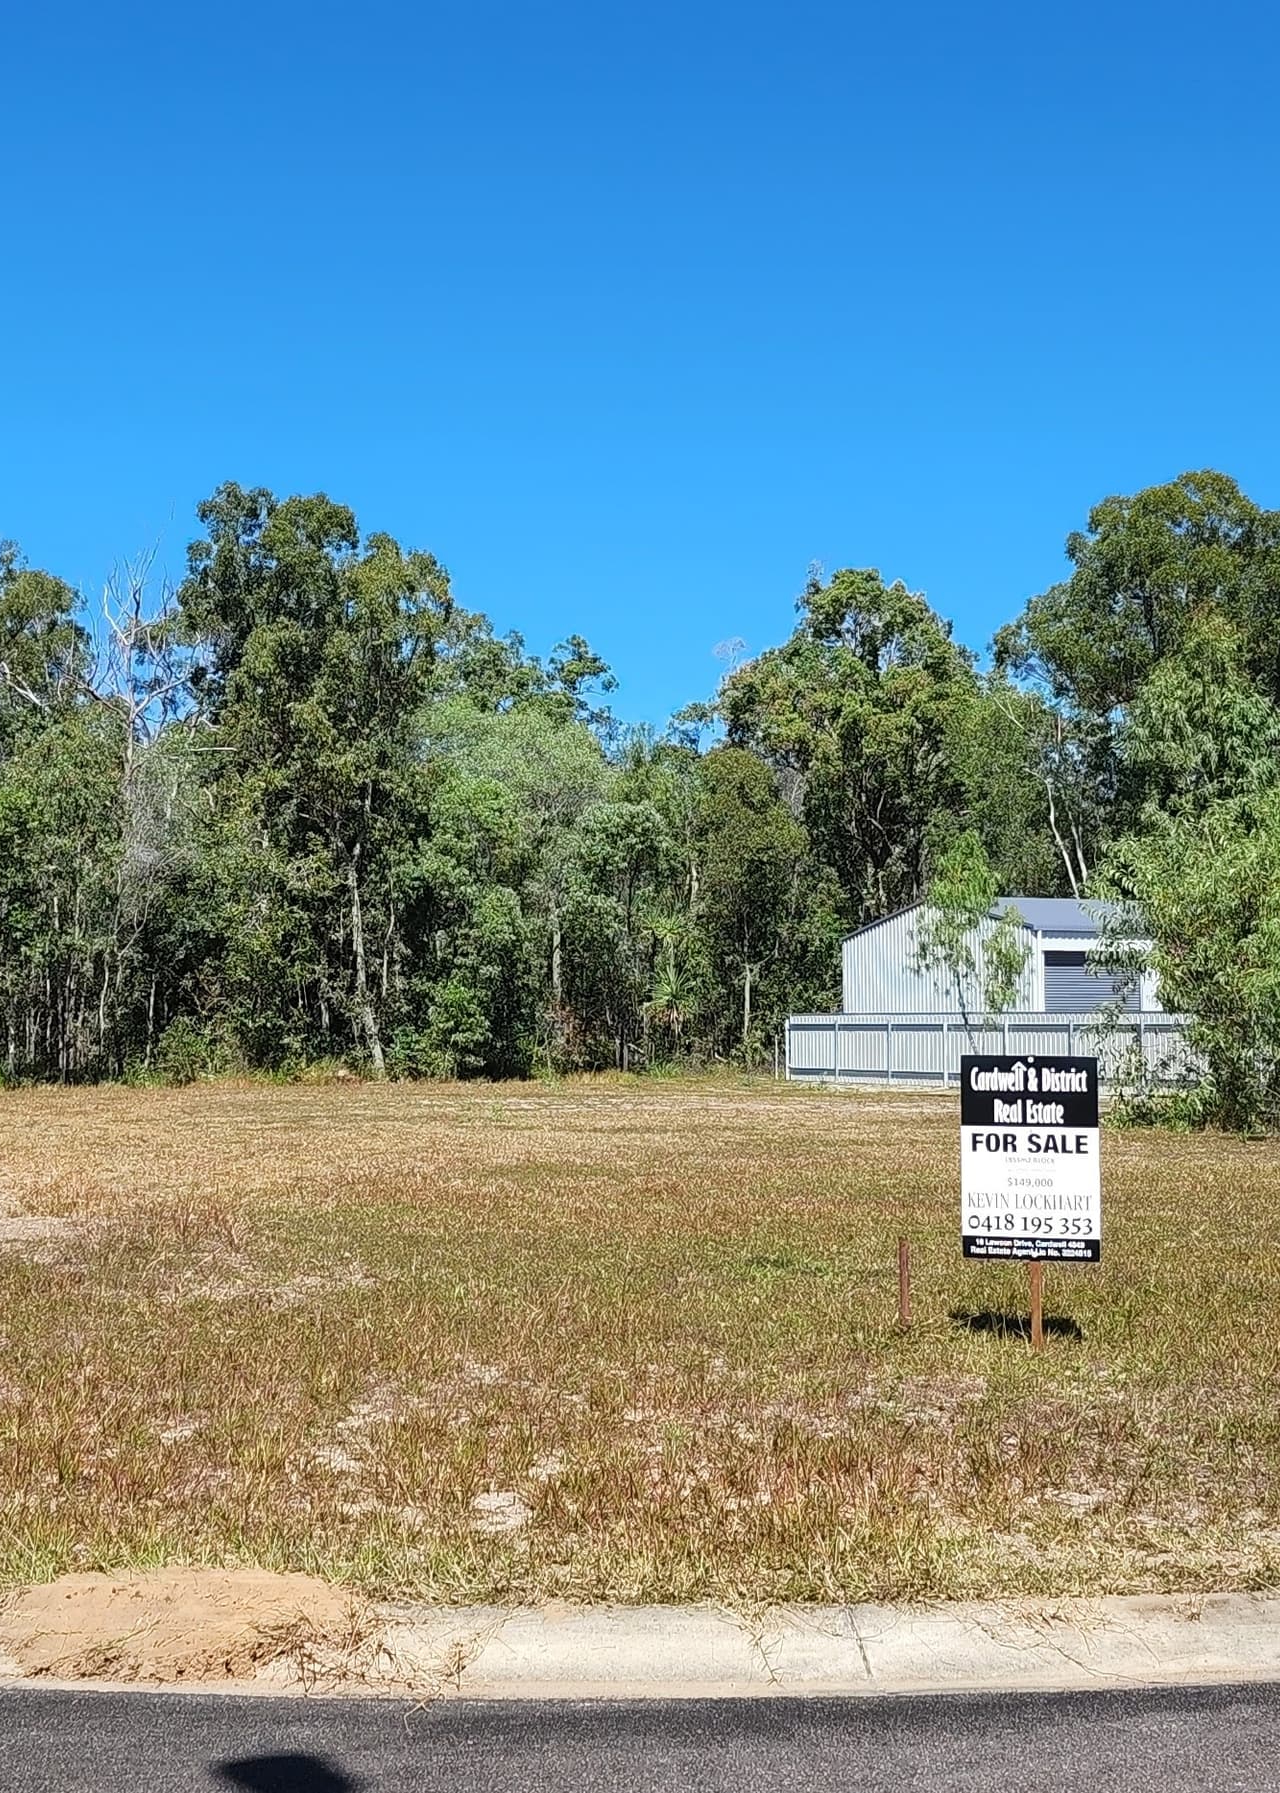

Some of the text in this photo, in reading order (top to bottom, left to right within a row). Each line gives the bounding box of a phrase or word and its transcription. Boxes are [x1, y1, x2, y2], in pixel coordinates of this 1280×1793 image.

[970, 1065, 1088, 1092] Cardwell & District
[993, 1098, 1065, 1124] Real Estate
[971, 1133, 1089, 1154] FOR SALE
[1007, 1177, 1053, 1188] $149,000
[968, 1192, 1092, 1211] KEVIN LOCKHART
[968, 1213, 1093, 1235] 0418 195 353
